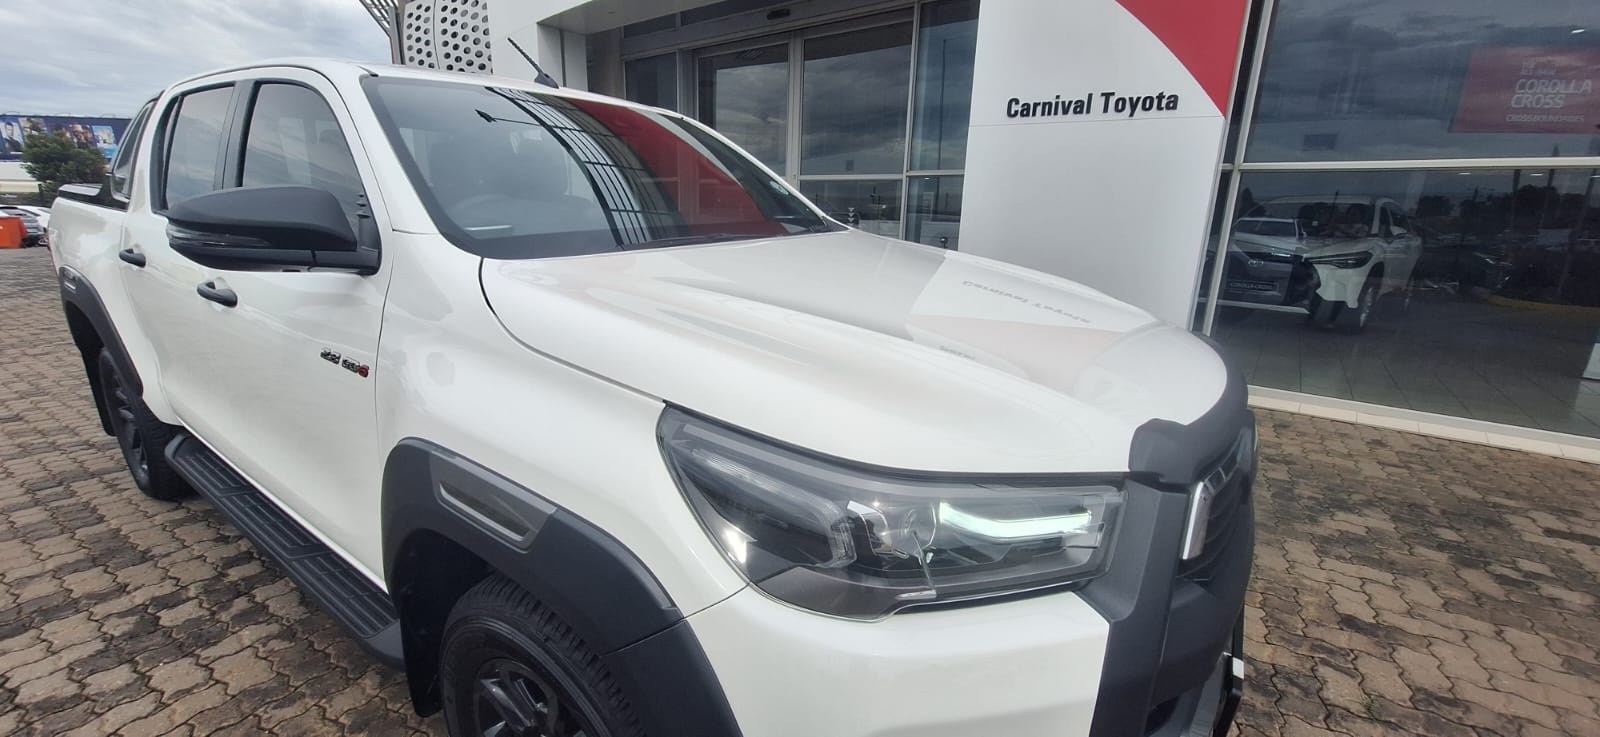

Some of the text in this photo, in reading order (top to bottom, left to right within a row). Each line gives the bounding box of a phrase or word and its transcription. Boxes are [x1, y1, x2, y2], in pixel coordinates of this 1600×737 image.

[1515, 78, 1593, 94] COROLLA
[1006, 91, 1179, 118] Carnival Toyota
[1510, 93, 1566, 109] CROSS
